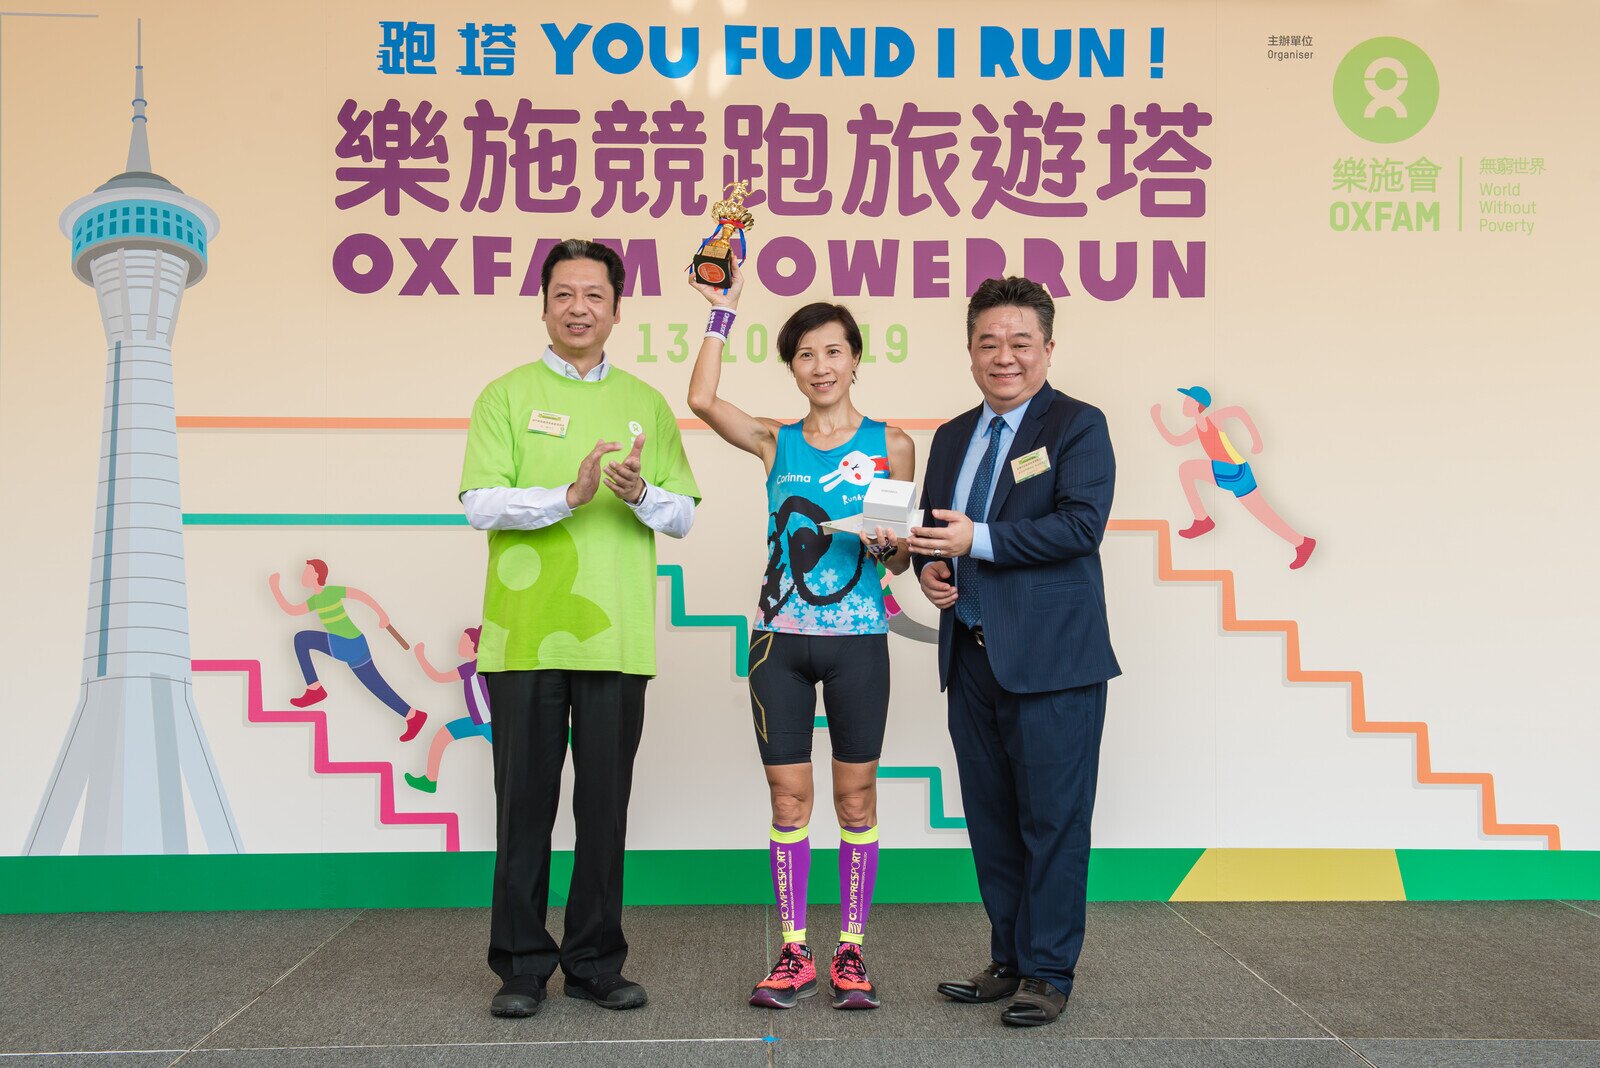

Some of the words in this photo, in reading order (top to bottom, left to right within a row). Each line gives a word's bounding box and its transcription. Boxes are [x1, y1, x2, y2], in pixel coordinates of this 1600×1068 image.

[1267, 34, 1313, 47] 主辦單位
[376, 21, 437, 75] 跑
[456, 22, 517, 76] 塔
[540, 22, 700, 79] YOU
[724, 24, 915, 79] FUND
[937, 27, 955, 79] I
[980, 26, 1125, 81] RUN
[1267, 49, 1314, 61] Organiser
[335, 98, 1213, 221] 樂施競跑旅遊塔
[1479, 157, 1546, 176] 無窮世界
[1331, 156, 1442, 194] 樂施會
[1479, 182, 1520, 197] World
[1329, 201, 1441, 232] OXFAM
[1479, 200, 1536, 215] Without
[1479, 218, 1535, 236] Poverty
[702, 236, 1206, 301] OWERRUN
[776, 472, 811, 484] Corinna
